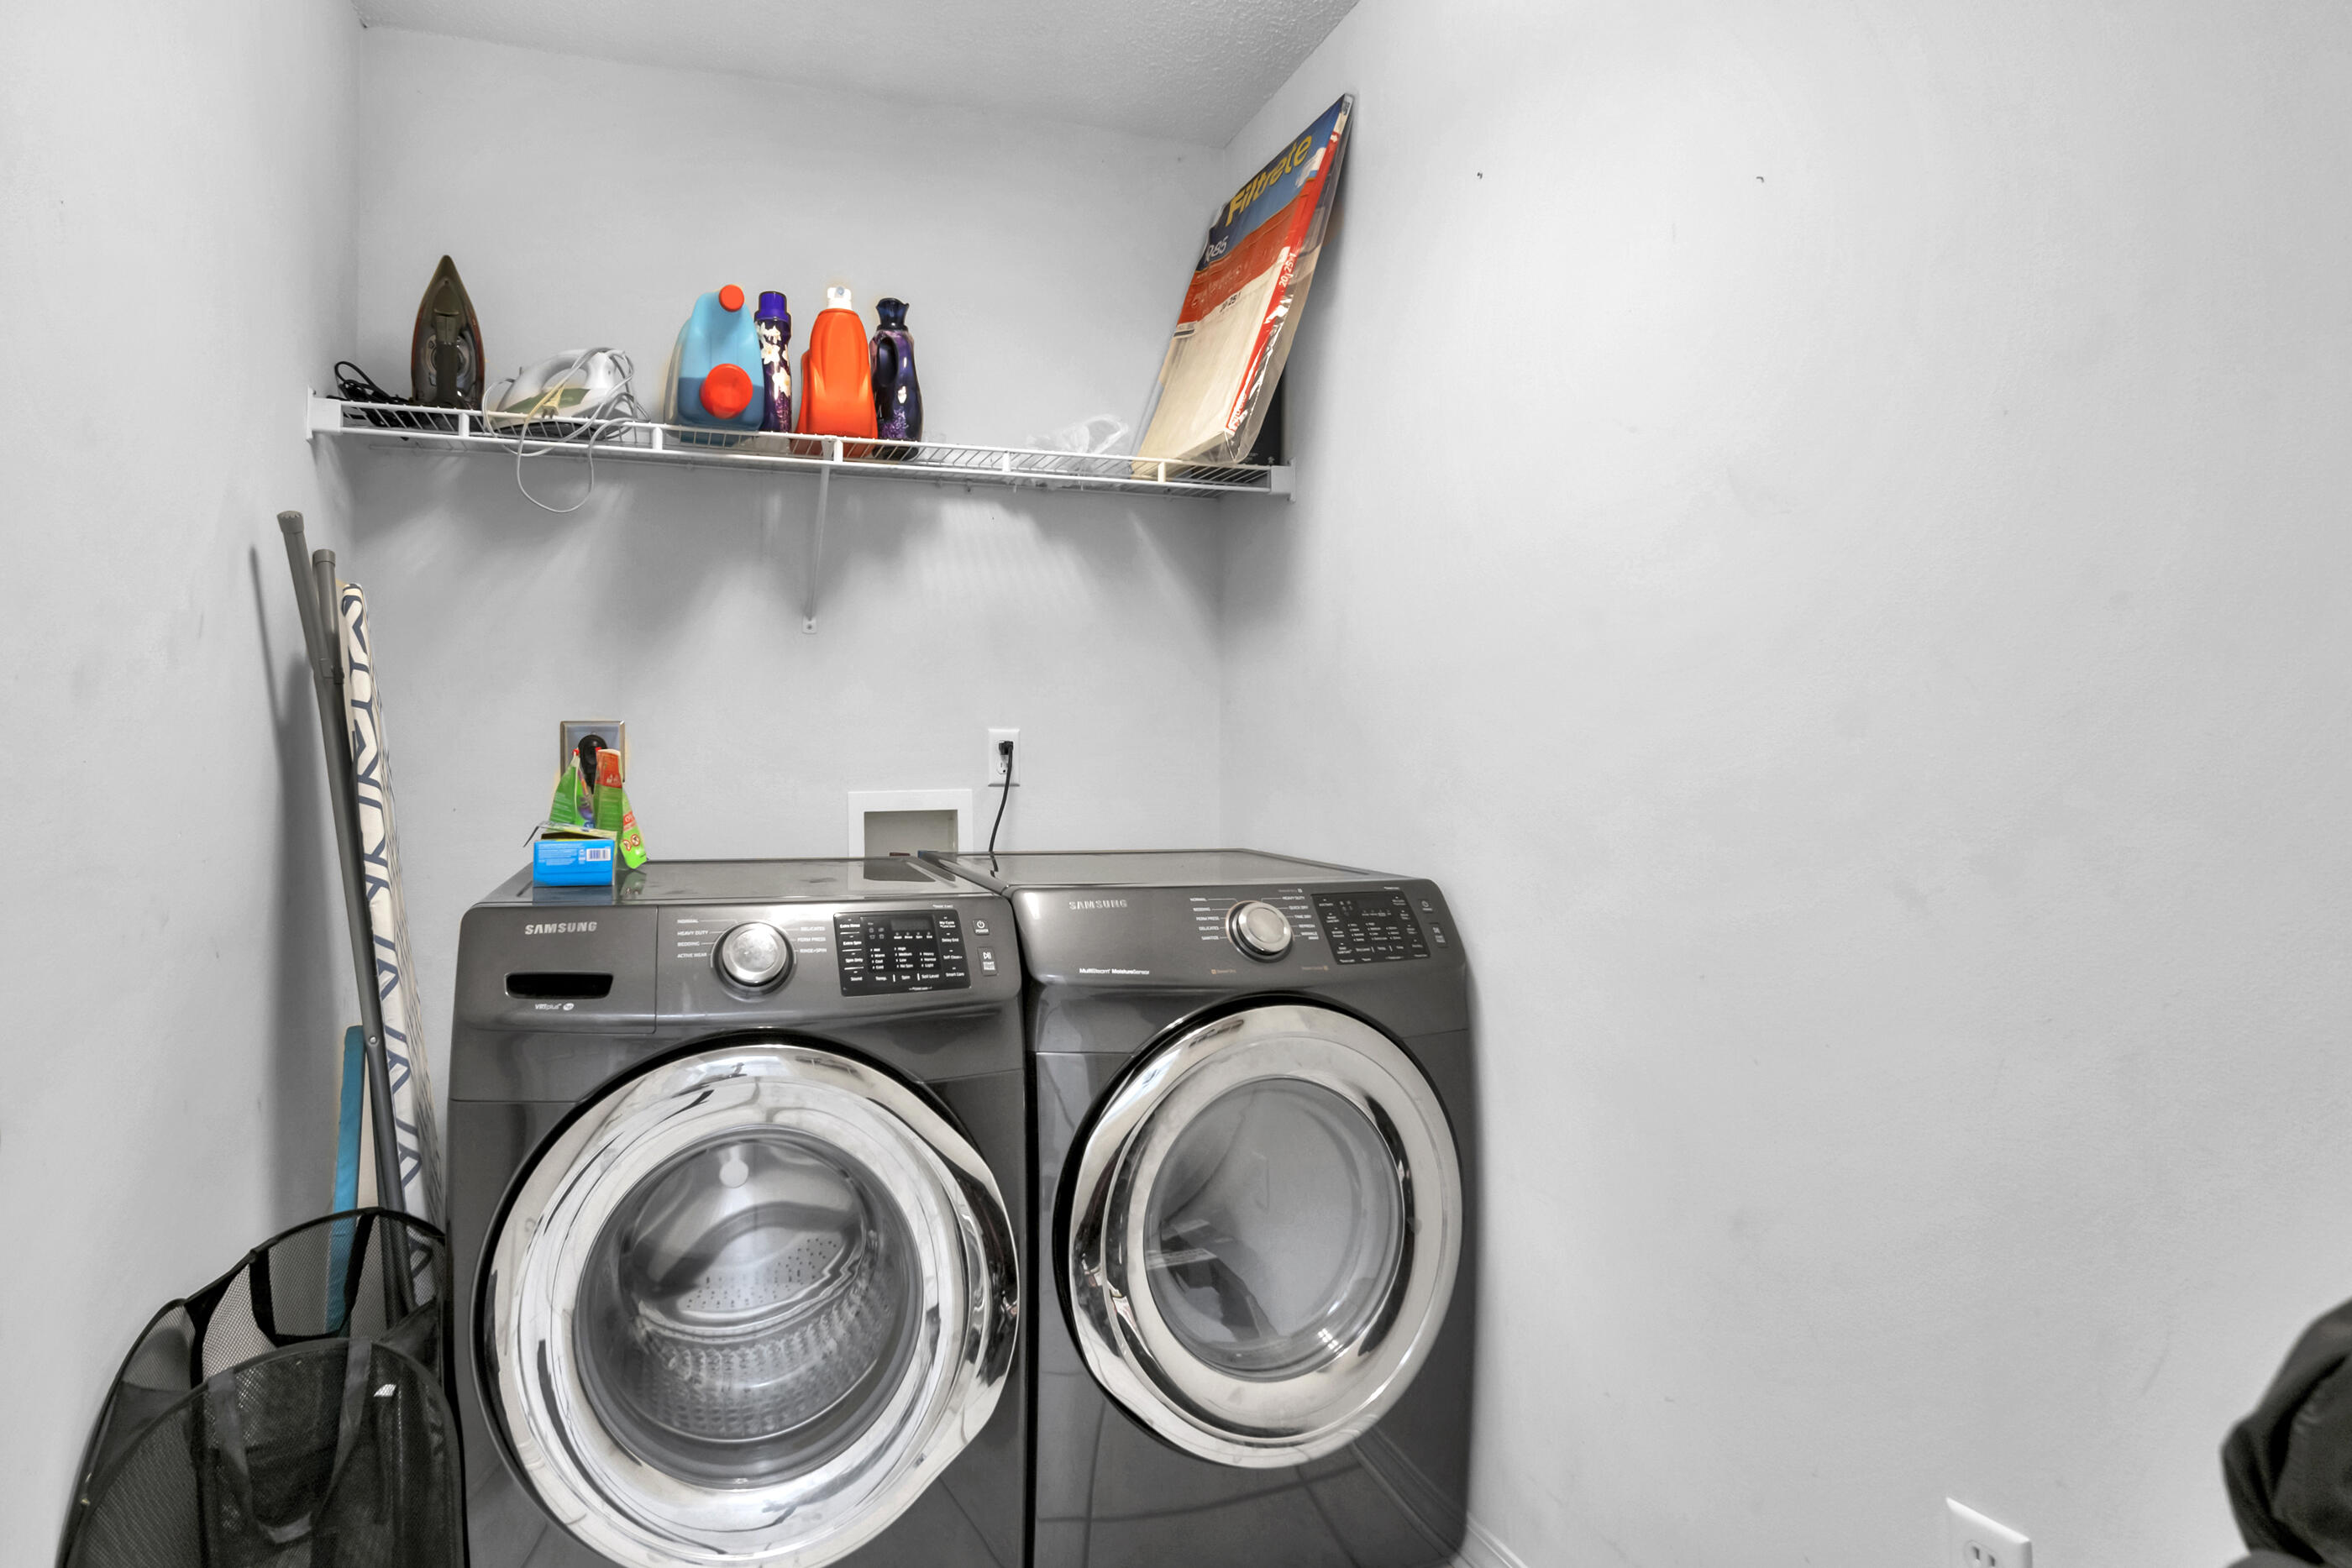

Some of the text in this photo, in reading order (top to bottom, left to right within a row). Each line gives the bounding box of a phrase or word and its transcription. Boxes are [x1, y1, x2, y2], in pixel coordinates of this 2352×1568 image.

[1226, 135, 1312, 227] Filtrete
[1068, 899, 1127, 910] SAMSUNG
[525, 921, 597, 935] SAMSUNG
